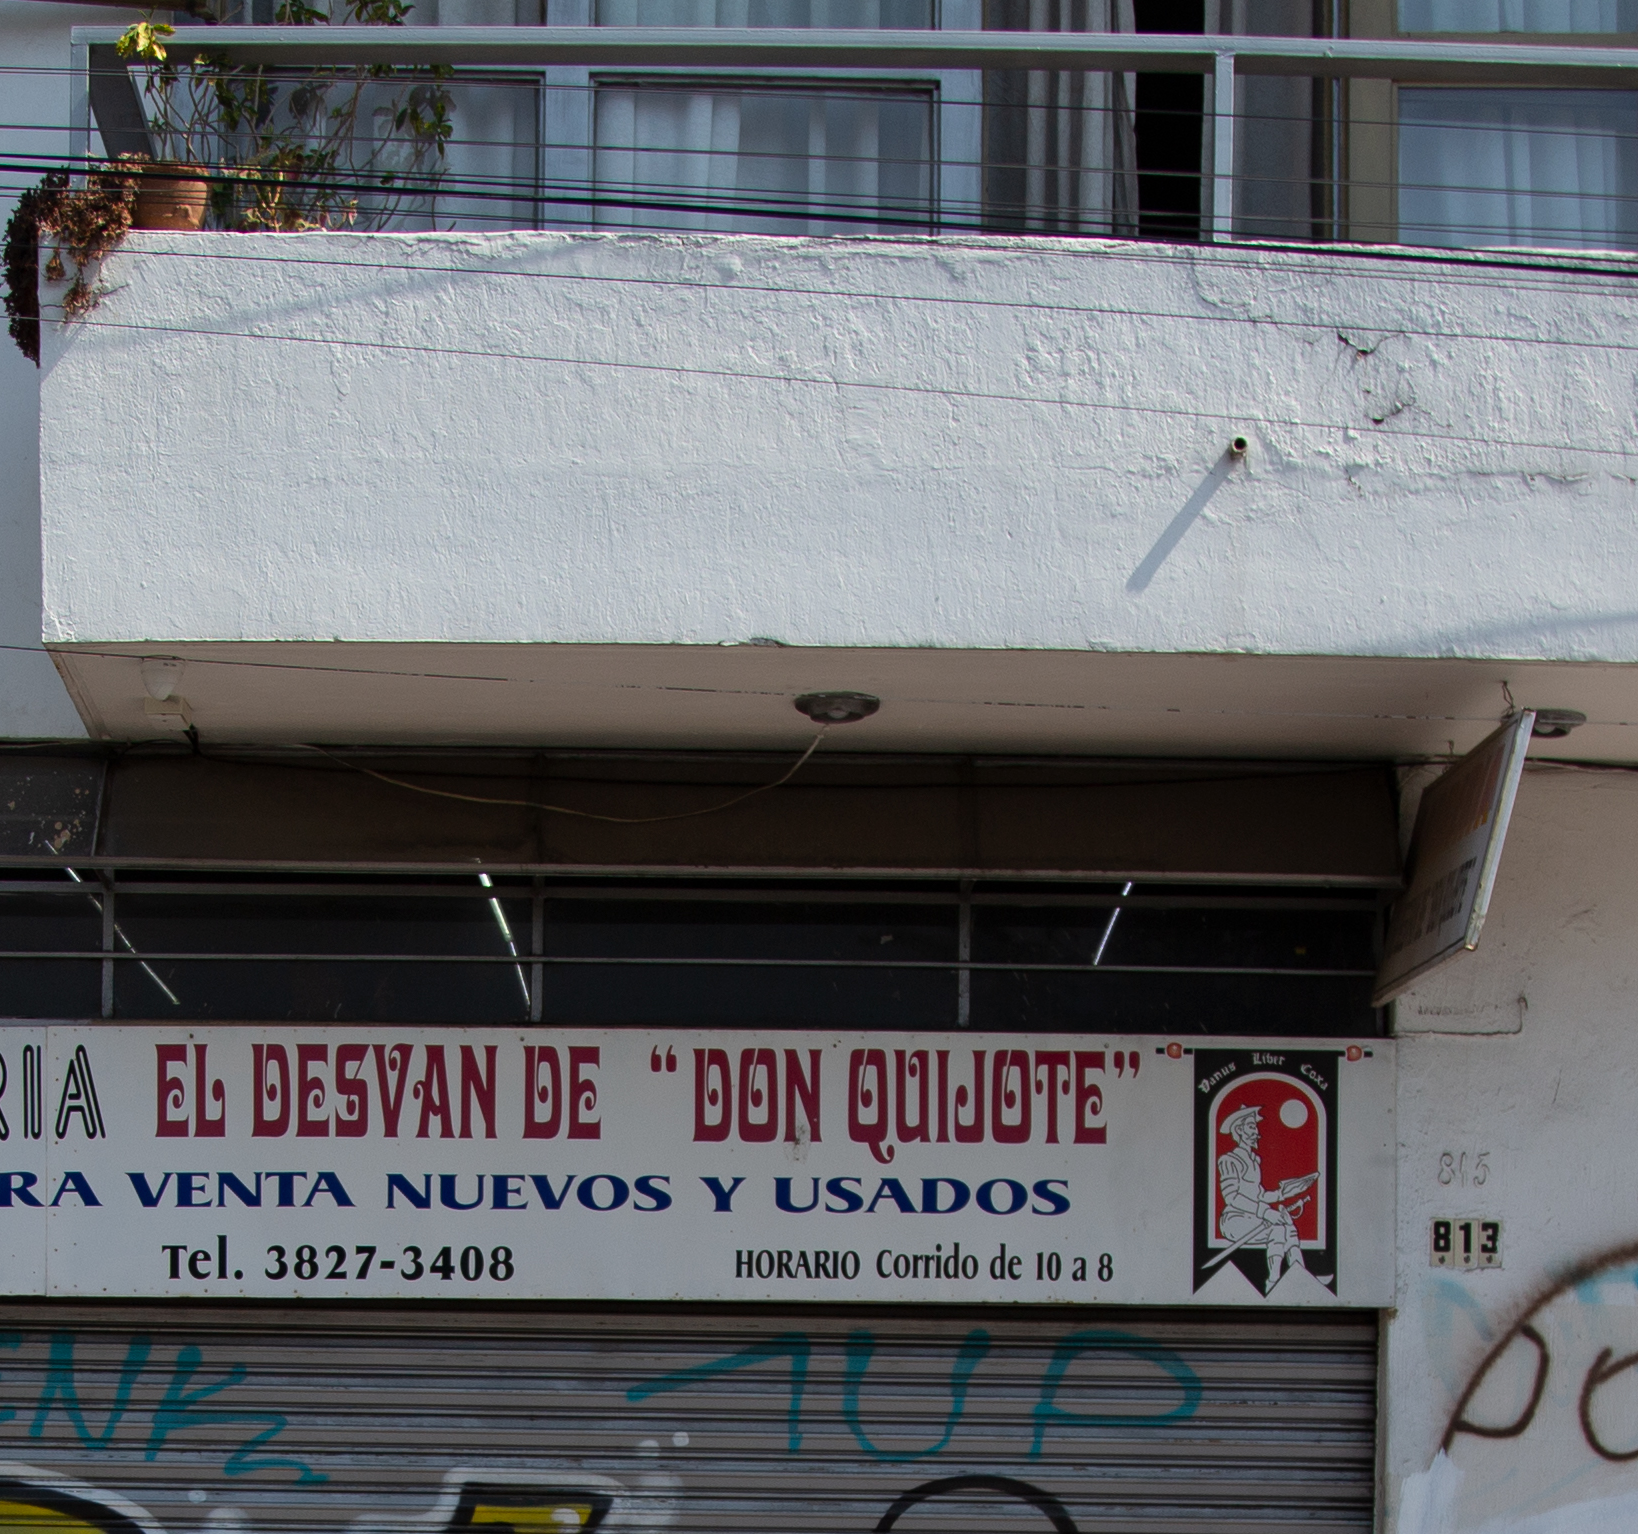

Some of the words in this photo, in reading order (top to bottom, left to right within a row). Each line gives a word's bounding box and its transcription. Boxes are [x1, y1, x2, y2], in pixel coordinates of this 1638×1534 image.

[154, 1043, 226, 1138] EL
[251, 1042, 499, 1139] DESVAN
[522, 1045, 602, 1140] DE
[125, 1171, 356, 1209] VENTA
[385, 1173, 673, 1212] NUEVOS
[698, 1176, 747, 1213] Y
[773, 1176, 1071, 1216] USADOS
[161, 1234, 244, 1281] Tel.
[264, 1244, 515, 1282] 3827-3408
[1434, 1220, 1499, 1254] 813
[735, 1249, 861, 1281] HORARIO
[875, 1242, 979, 1281] Corrido
[989, 1242, 1023, 1281] de
[1036, 1251, 1062, 1282] 10
[1071, 1256, 1087, 1282] a
[1097, 1252, 1114, 1283] 8
